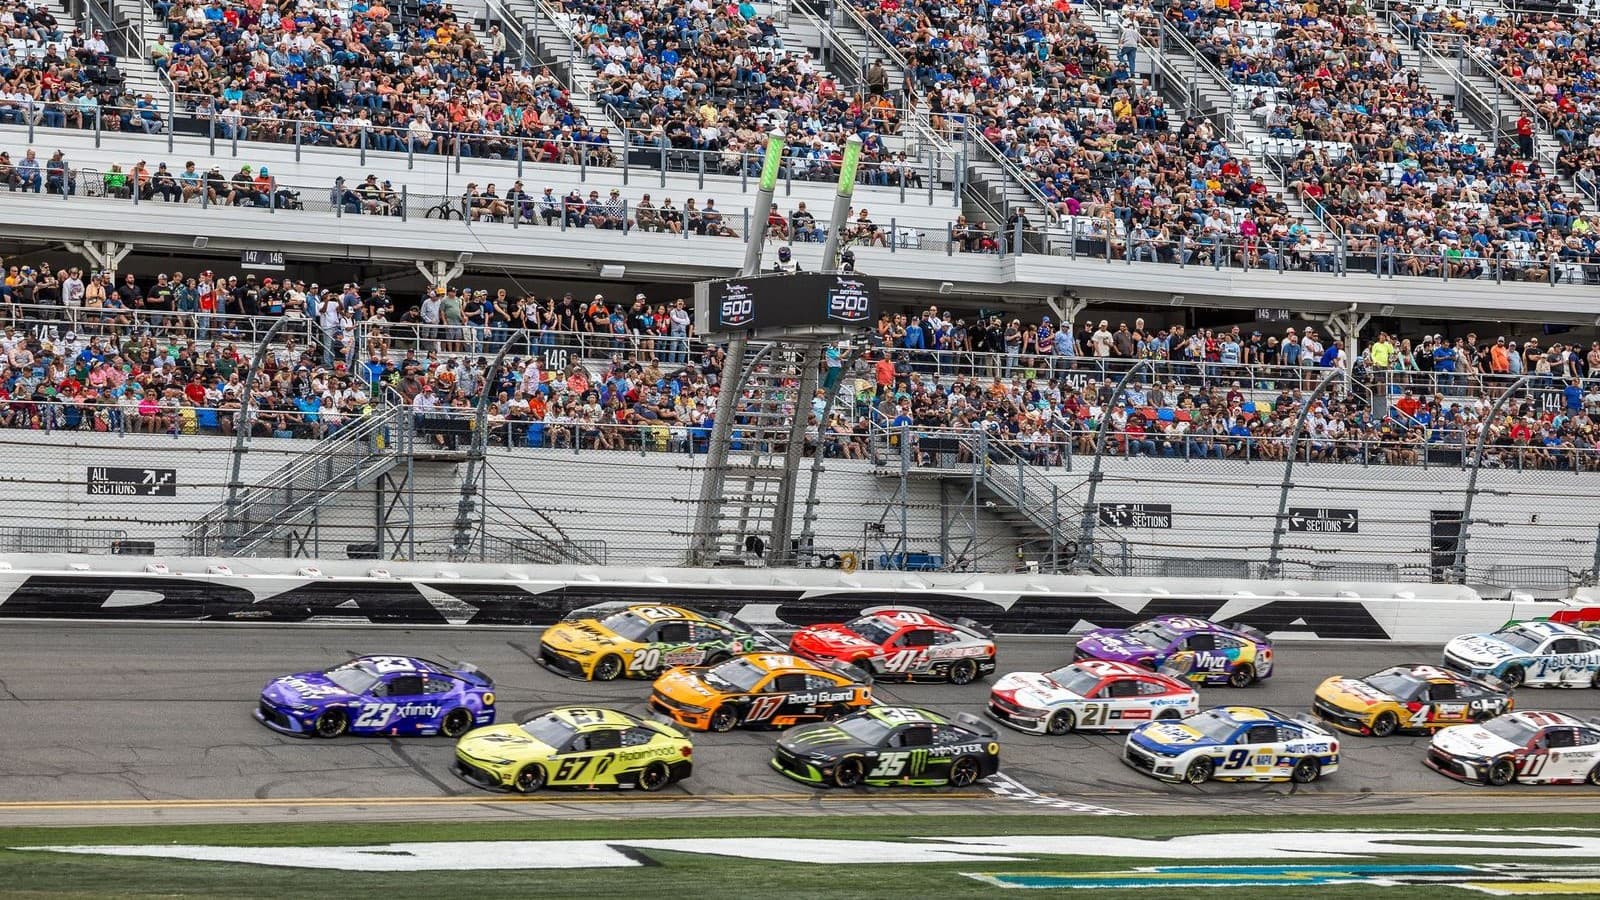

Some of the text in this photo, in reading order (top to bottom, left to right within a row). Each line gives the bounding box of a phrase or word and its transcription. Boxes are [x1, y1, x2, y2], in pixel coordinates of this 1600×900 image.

[246, 251, 283, 264] 147 146
[722, 300, 752, 316] 500
[831, 295, 868, 311] 500
[1258, 309, 1289, 320] 145 144
[543, 349, 567, 370] 146
[1540, 392, 1561, 412] 144
[92, 468, 109, 481] ALL
[91, 481, 137, 495] SECTIONS
[1132, 504, 1146, 515] ALL
[1317, 508, 1329, 519] ALL
[1132, 515, 1169, 528] SECTIONS
[1305, 520, 1342, 532] SECTIONS
[371, 656, 418, 673] 23
[629, 648, 661, 671] 20
[884, 649, 917, 673] 41
[1196, 650, 1228, 668] Viva
[1536, 658, 1551, 678] 1
[1551, 655, 1586, 668] BUSCH
[354, 702, 442, 727] 23 xfinity
[746, 690, 854, 722] 17 Body Guard
[883, 707, 924, 721] 35
[1081, 703, 1110, 726] 21
[1408, 705, 1431, 727] 4
[553, 746, 676, 781] 67 Robinhood
[868, 743, 985, 777] 35 MONSTER
[1224, 749, 1250, 769] 9
[1285, 743, 1306, 754] AUTO
[1307, 742, 1329, 753] PARTS
[1519, 754, 1547, 776] 11
